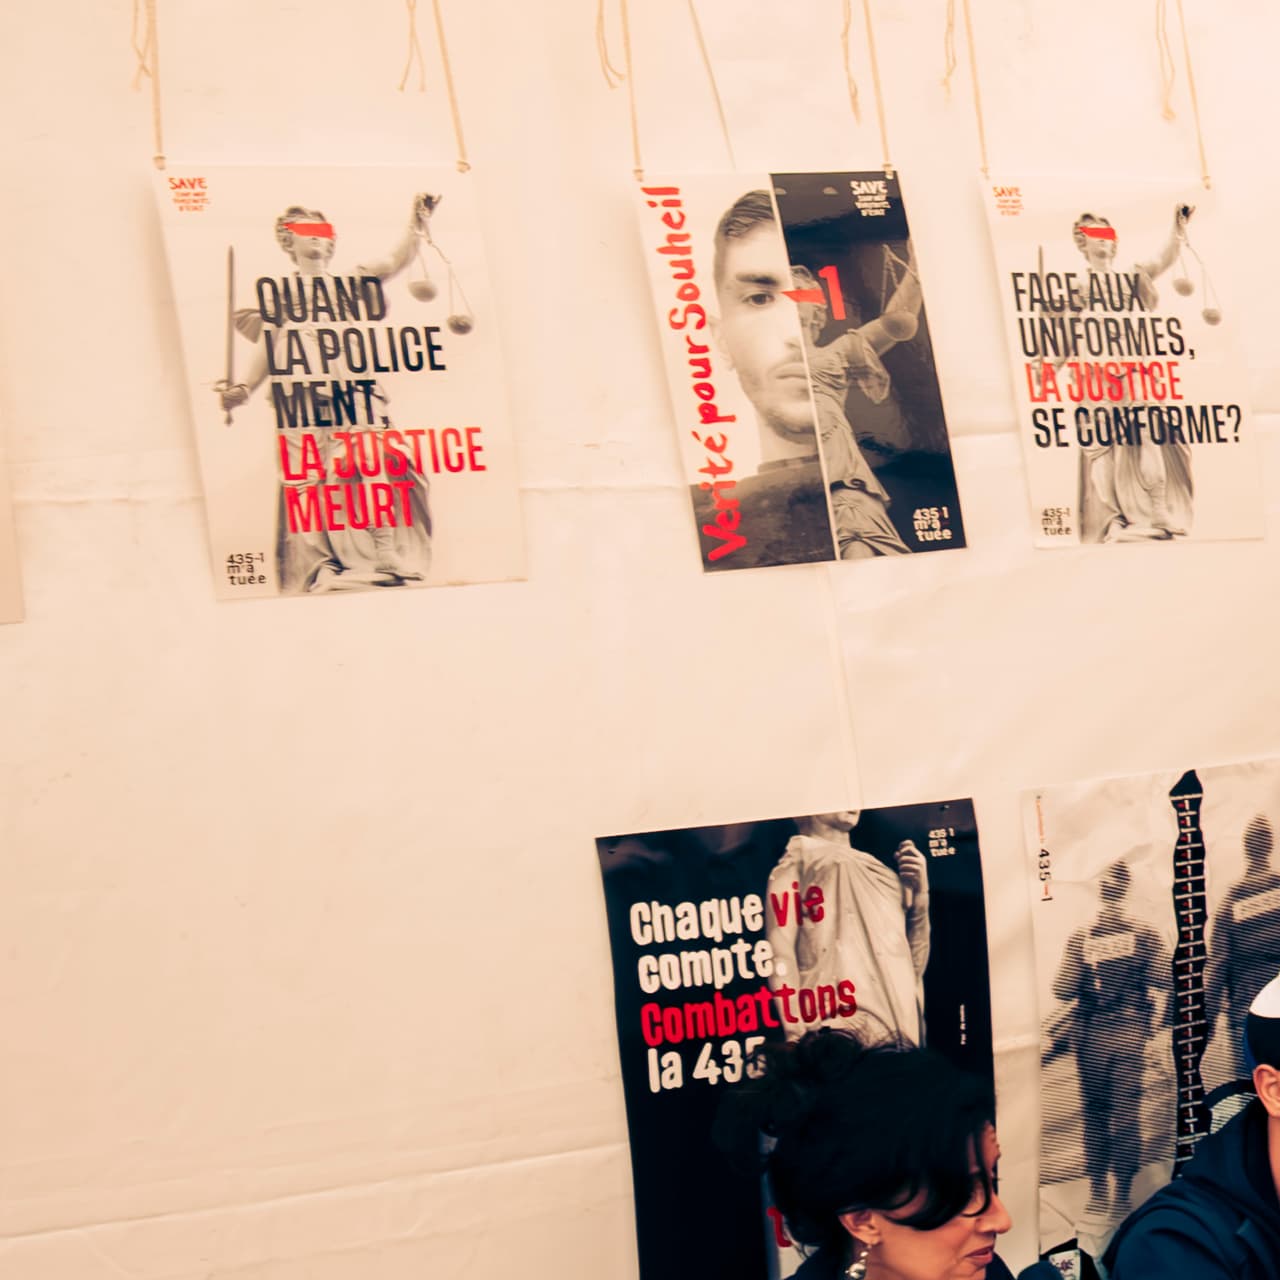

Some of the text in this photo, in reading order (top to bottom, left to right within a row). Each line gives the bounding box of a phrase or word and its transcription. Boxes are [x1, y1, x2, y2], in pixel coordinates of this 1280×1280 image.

[168, 177, 208, 190] SAVE
[850, 181, 887, 195] SAVE
[641, 186, 706, 331] Souheil
[256, 276, 387, 328] QUAND
[1011, 272, 1145, 312] FACE AUX
[264, 326, 446, 376] LA POLICE
[1017, 316, 1196, 361] UNIFORMES,
[272, 379, 390, 430] MENT,
[685, 335, 736, 424] pour
[1025, 361, 1184, 403] LA JUSTICE
[1032, 404, 1243, 448] SE CONFORME?
[279, 427, 486, 481] LA JUSTICE
[284, 480, 416, 533] MEURT
[630, 881, 825, 946] Chaque vie
[637, 938, 787, 994] compte.
[641, 979, 857, 1047] Combattons
[648, 1047, 684, 1093] la
